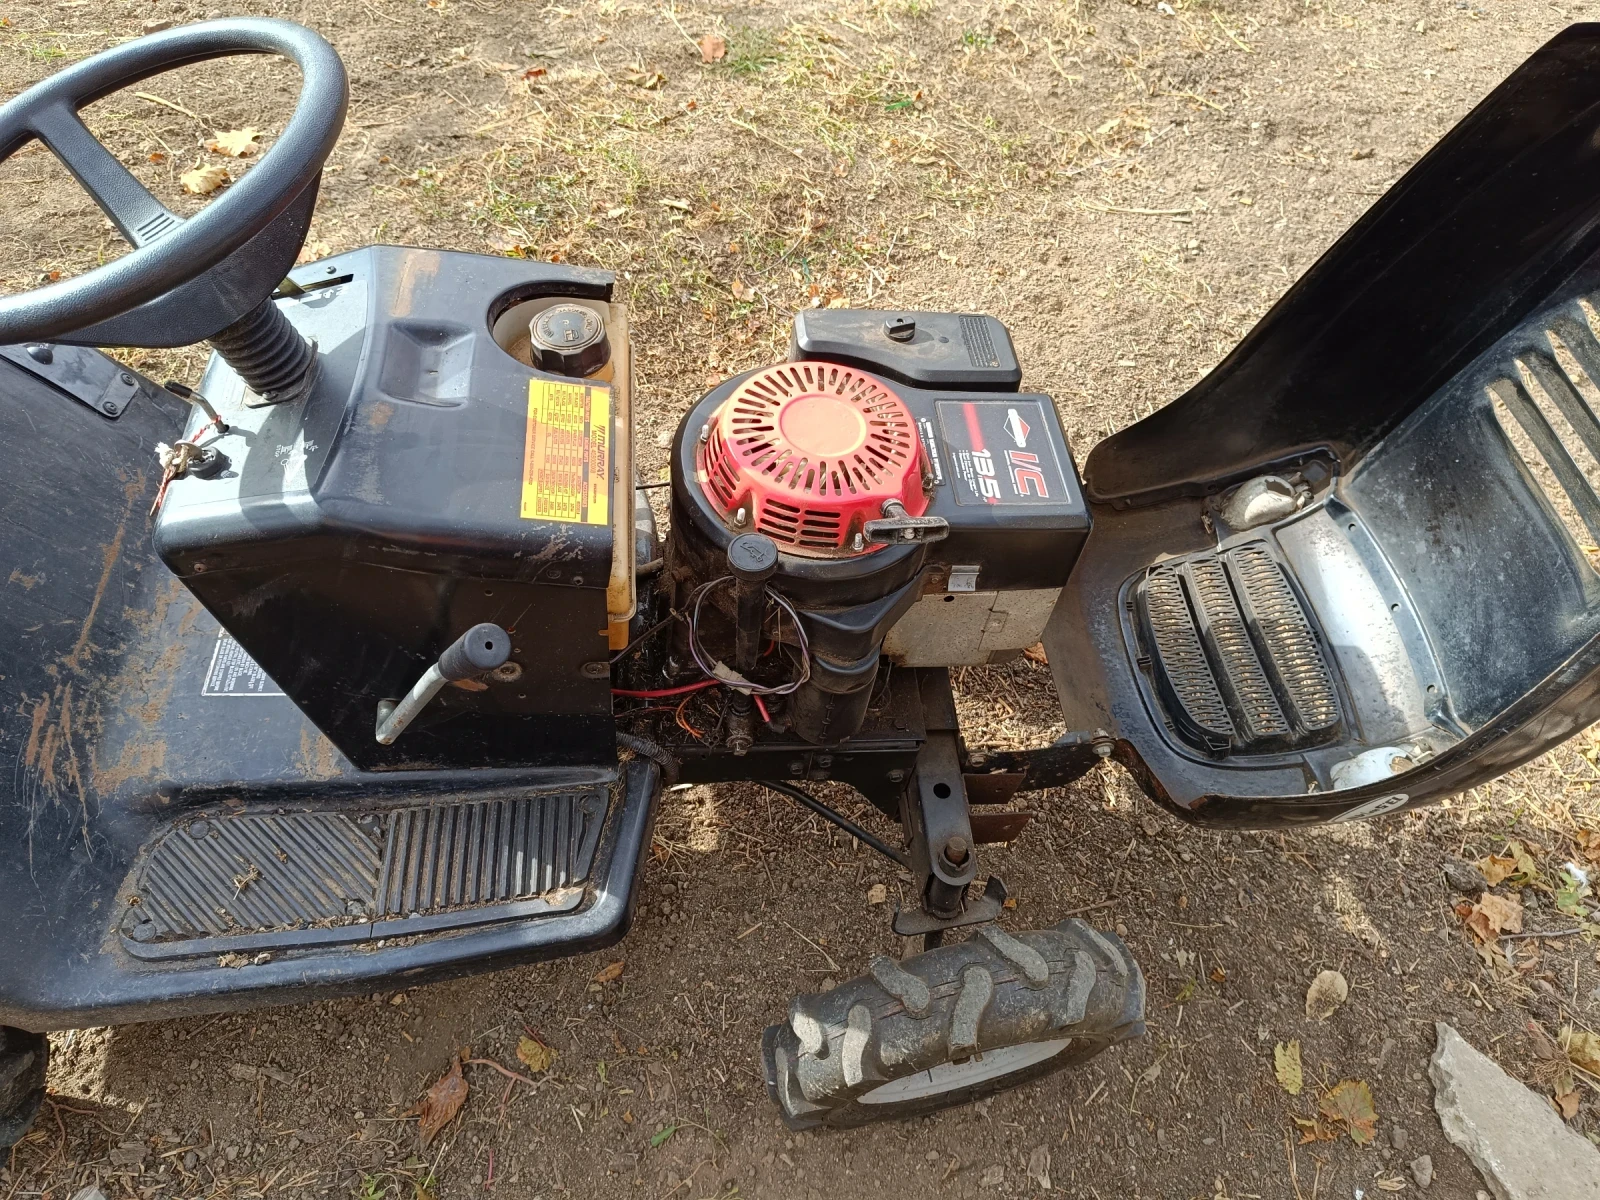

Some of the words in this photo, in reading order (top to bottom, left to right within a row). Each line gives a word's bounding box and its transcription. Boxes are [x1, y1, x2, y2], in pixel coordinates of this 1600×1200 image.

[596, 433, 605, 480] MURRAY
[971, 448, 1001, 499] 13.5
[1009, 449, 1049, 498] I/C
